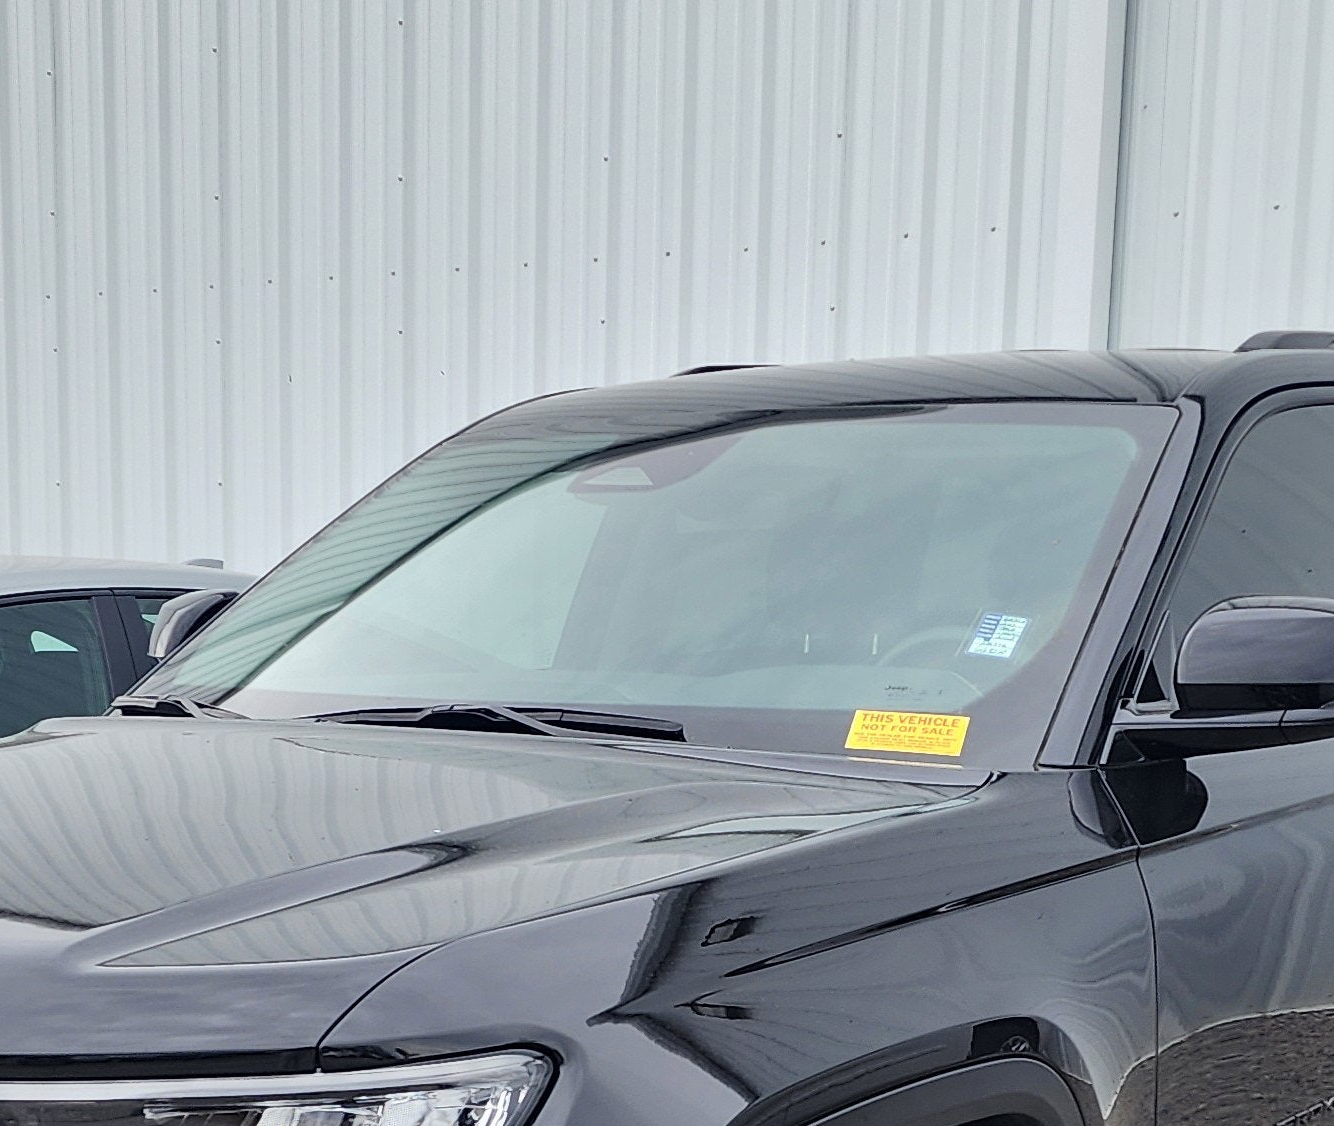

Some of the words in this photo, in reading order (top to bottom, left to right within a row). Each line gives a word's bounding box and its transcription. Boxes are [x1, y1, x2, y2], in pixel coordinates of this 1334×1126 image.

[862, 713, 894, 723] THIS
[898, 715, 960, 728] VEHICLE
[860, 723, 888, 731] NOT
[890, 725, 917, 733] FOR
[921, 728, 955, 736] SALE
